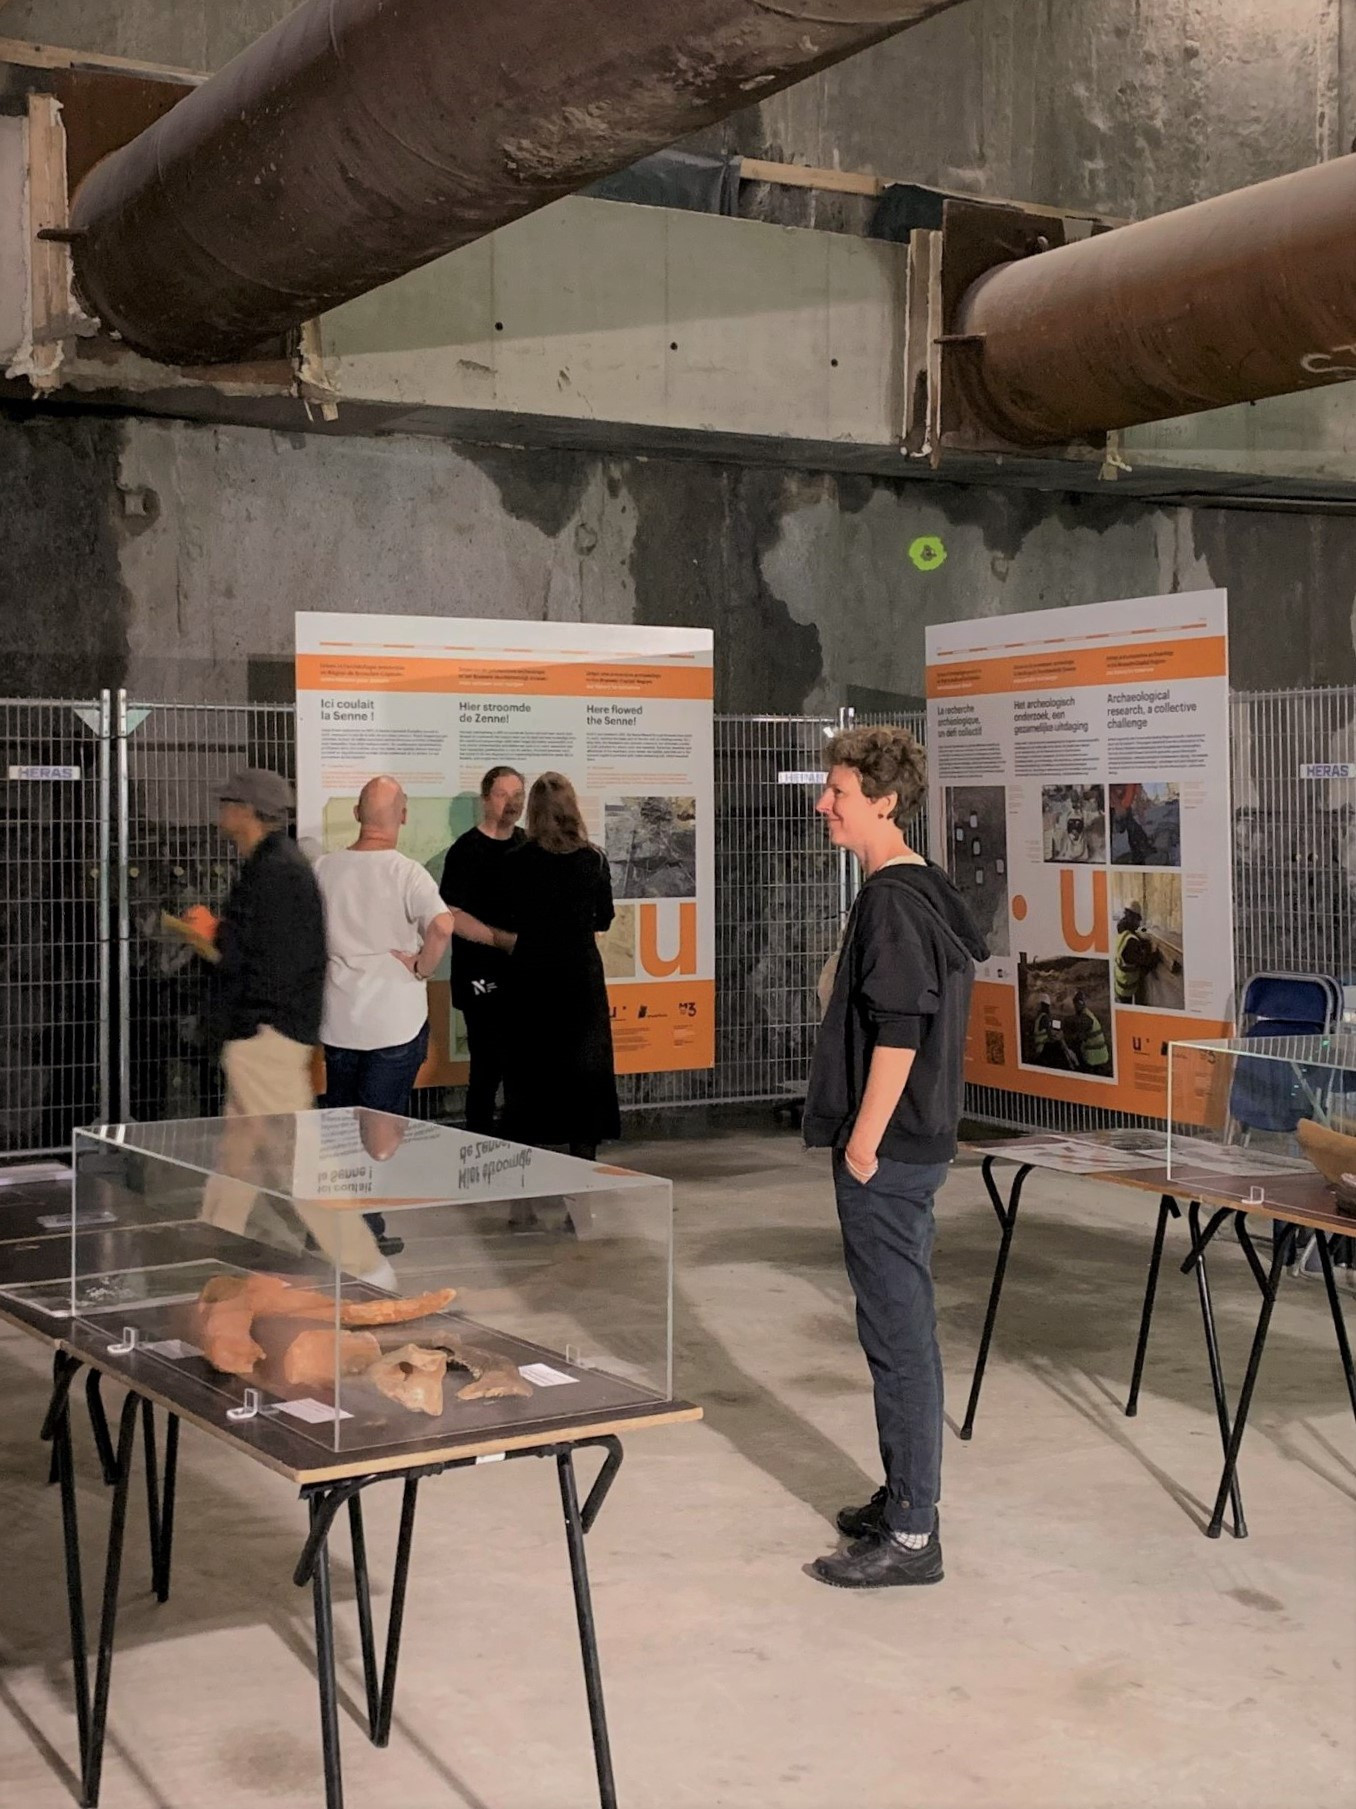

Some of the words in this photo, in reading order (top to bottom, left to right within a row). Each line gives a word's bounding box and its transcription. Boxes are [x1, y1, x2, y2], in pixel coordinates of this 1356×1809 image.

[1107, 689, 1170, 704] Archaeological
[321, 698, 334, 709] Ici
[336, 698, 375, 710] coulait
[459, 701, 481, 711] Hier
[483, 702, 532, 713] stroomde
[586, 704, 610, 714] Here
[611, 704, 643, 715] flowed
[1107, 704, 1146, 716] research,
[1147, 705, 1153, 714] a
[1153, 701, 1198, 714] collective
[321, 710, 331, 720] la
[333, 711, 368, 721] Senne
[459, 713, 472, 723] de
[475, 713, 510, 724] Zenne!
[586, 715, 603, 725] the
[604, 715, 637, 726] Senne!
[1106, 717, 1149, 730] challenge
[18, 767, 73, 779] HERAS
[1306, 765, 1350, 777] HERAS
[640, 903, 696, 977] u
